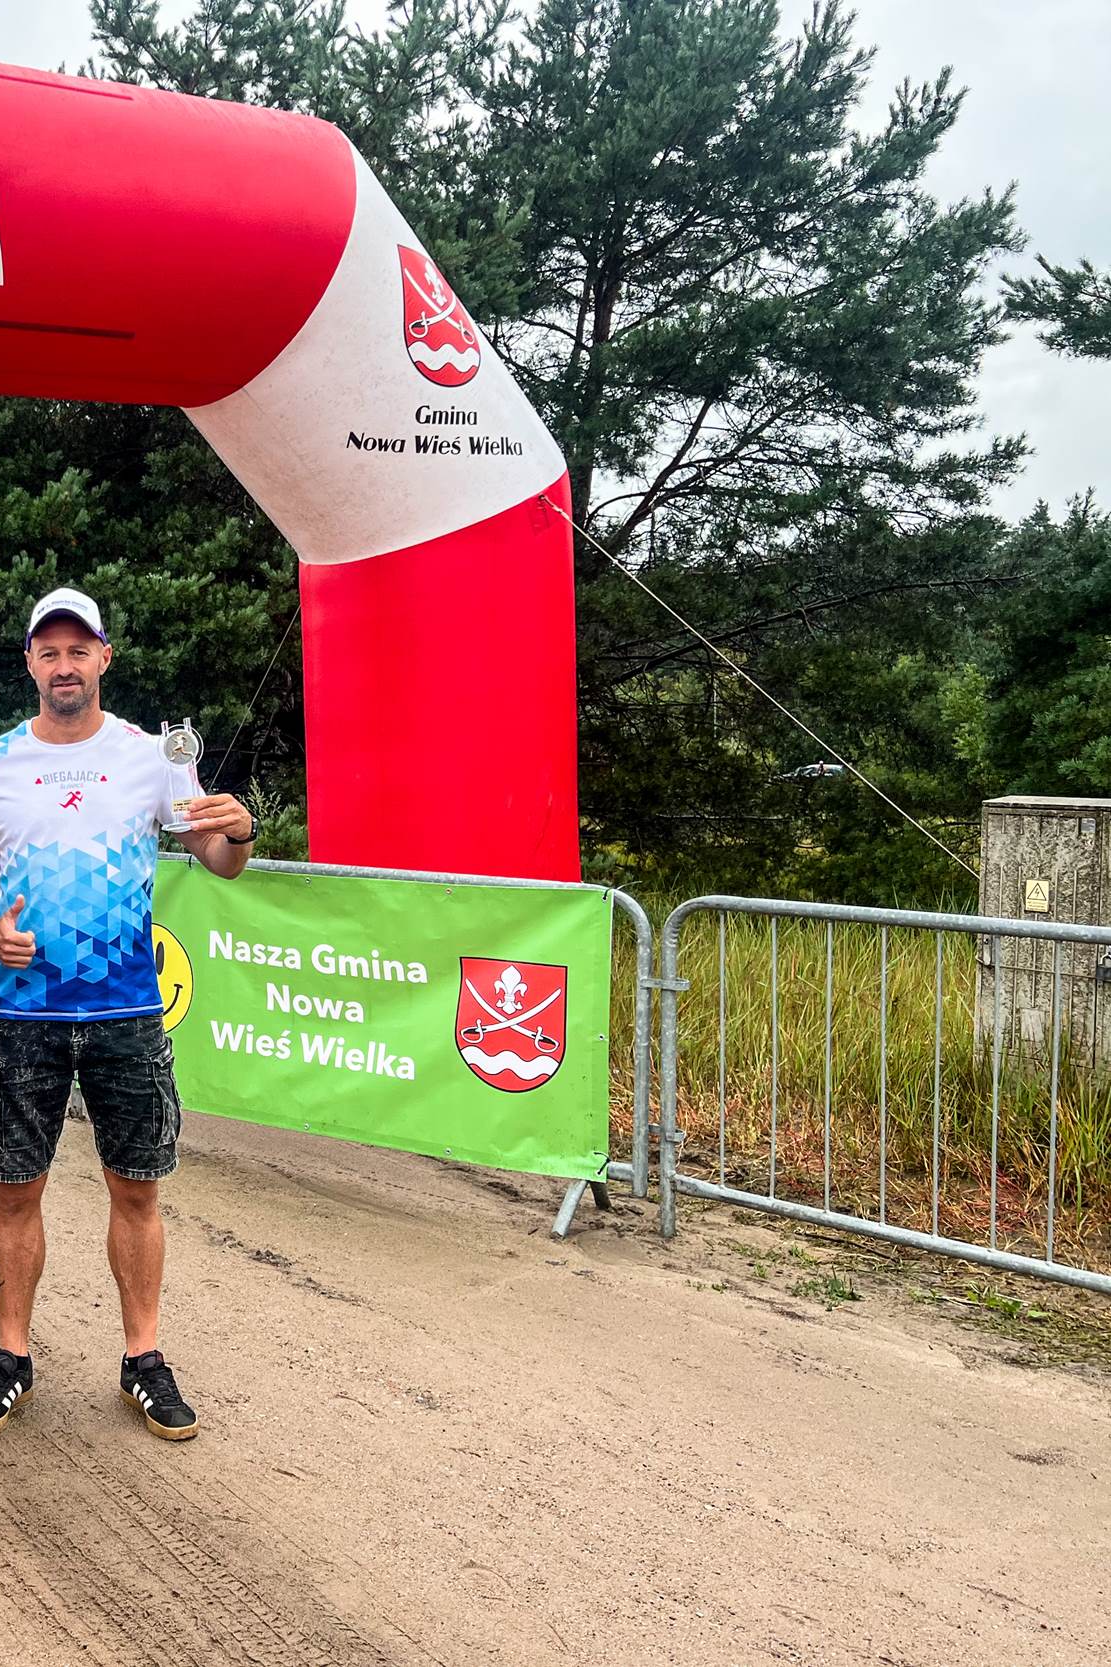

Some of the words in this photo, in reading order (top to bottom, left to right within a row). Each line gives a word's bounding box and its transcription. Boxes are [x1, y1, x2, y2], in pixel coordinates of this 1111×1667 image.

[415, 405, 478, 426] Gmina
[346, 431, 406, 453] Nowa
[415, 434, 461, 455] Wieś
[469, 437, 523, 456] Wielka
[209, 930, 301, 970] Nasza
[312, 944, 428, 984] Gmina
[266, 983, 364, 1023] Nowa
[210, 1021, 291, 1060] Wieś
[301, 1033, 416, 1080] Wielka
